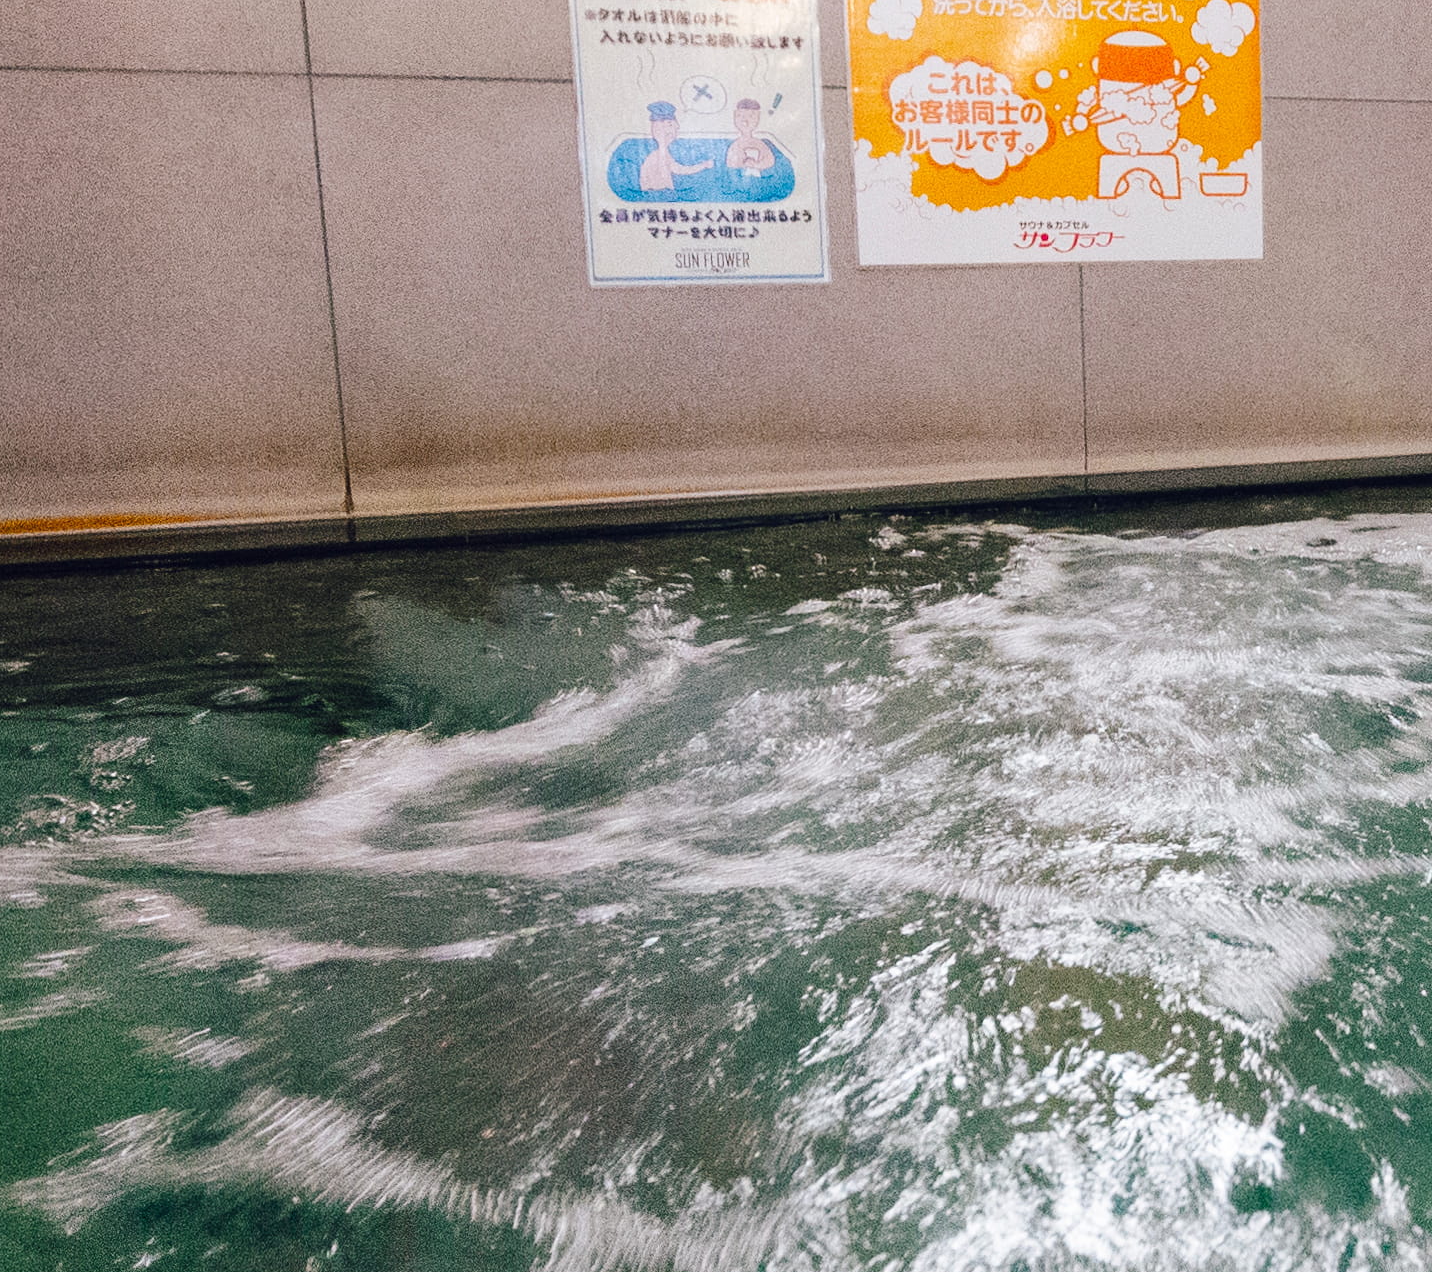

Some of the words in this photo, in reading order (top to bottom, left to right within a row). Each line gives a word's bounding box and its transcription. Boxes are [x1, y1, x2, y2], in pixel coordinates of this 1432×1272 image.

[928, 71, 1010, 96] これは、
[894, 98, 1043, 125] お客様同士の
[906, 129, 1035, 153] ルールです。
[675, 252, 700, 269] SUN
[703, 252, 751, 268] FLOWER
